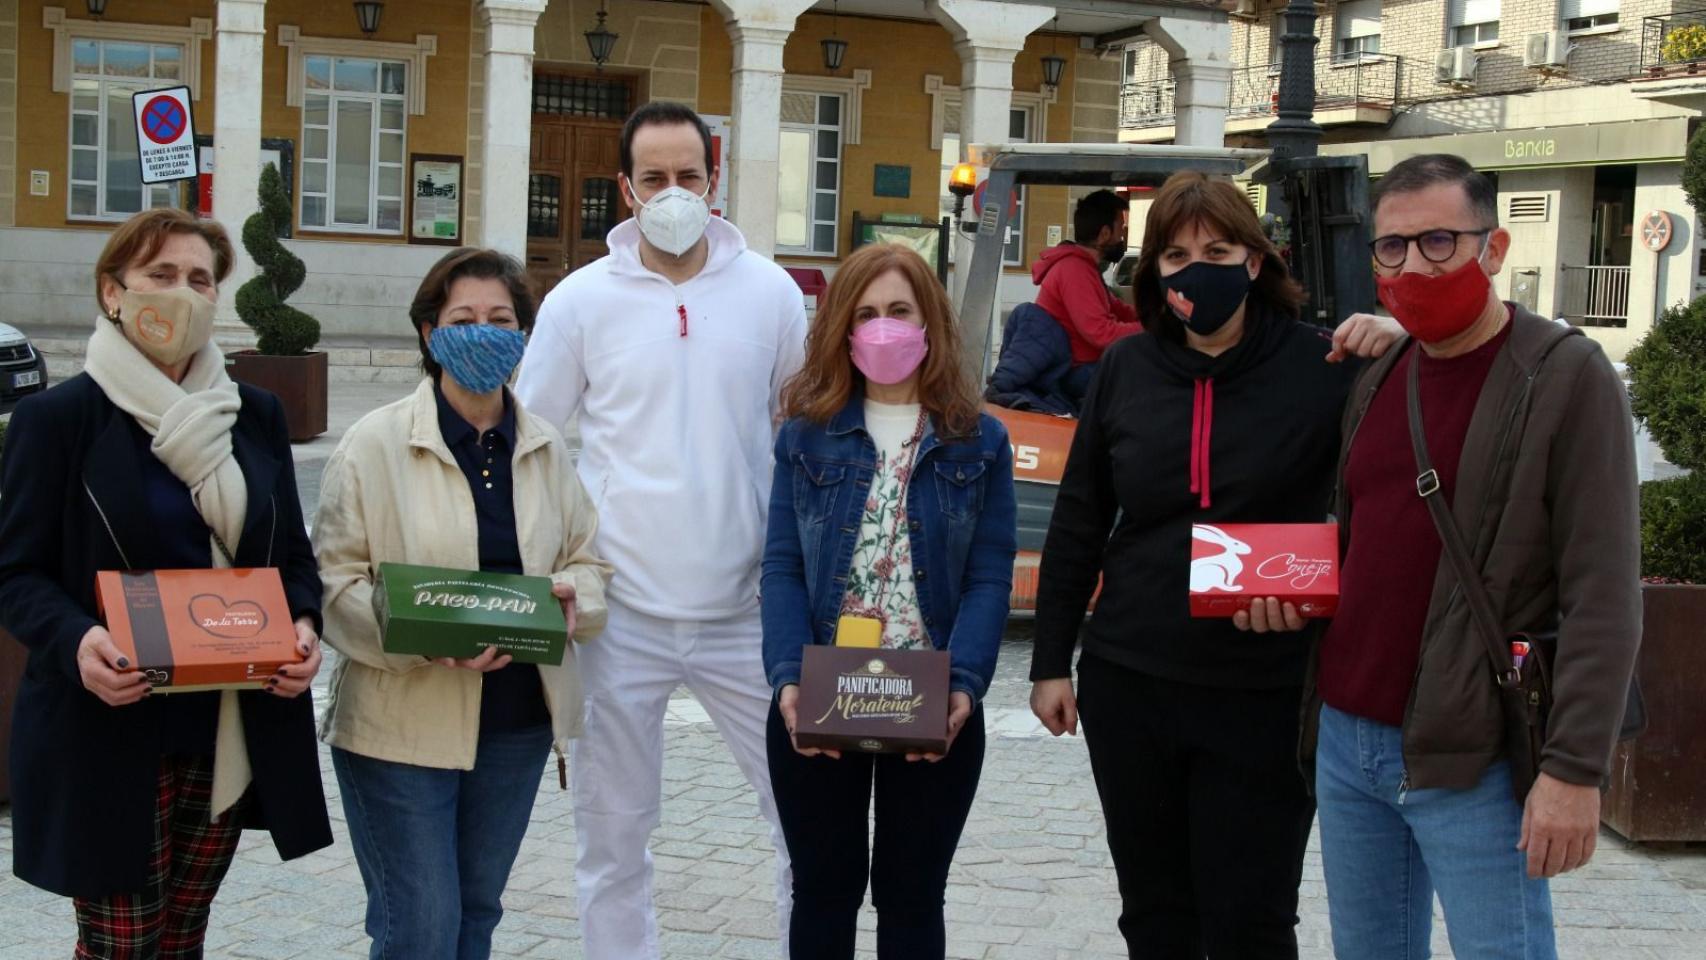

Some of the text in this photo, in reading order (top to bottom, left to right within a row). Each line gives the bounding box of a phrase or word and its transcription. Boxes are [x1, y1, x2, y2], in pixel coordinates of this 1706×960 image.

[150, 147, 166, 156] LUNES
[171, 144, 193, 153] VIERNES
[1504, 139, 1555, 158] Bankia
[159, 169, 185, 177] DESCARGA
[172, 160, 190, 169] CARGA
[1010, 444, 1040, 470] 5
[414, 590, 537, 615] PACO-PAN
[837, 676, 913, 696] PANIFICADORA
